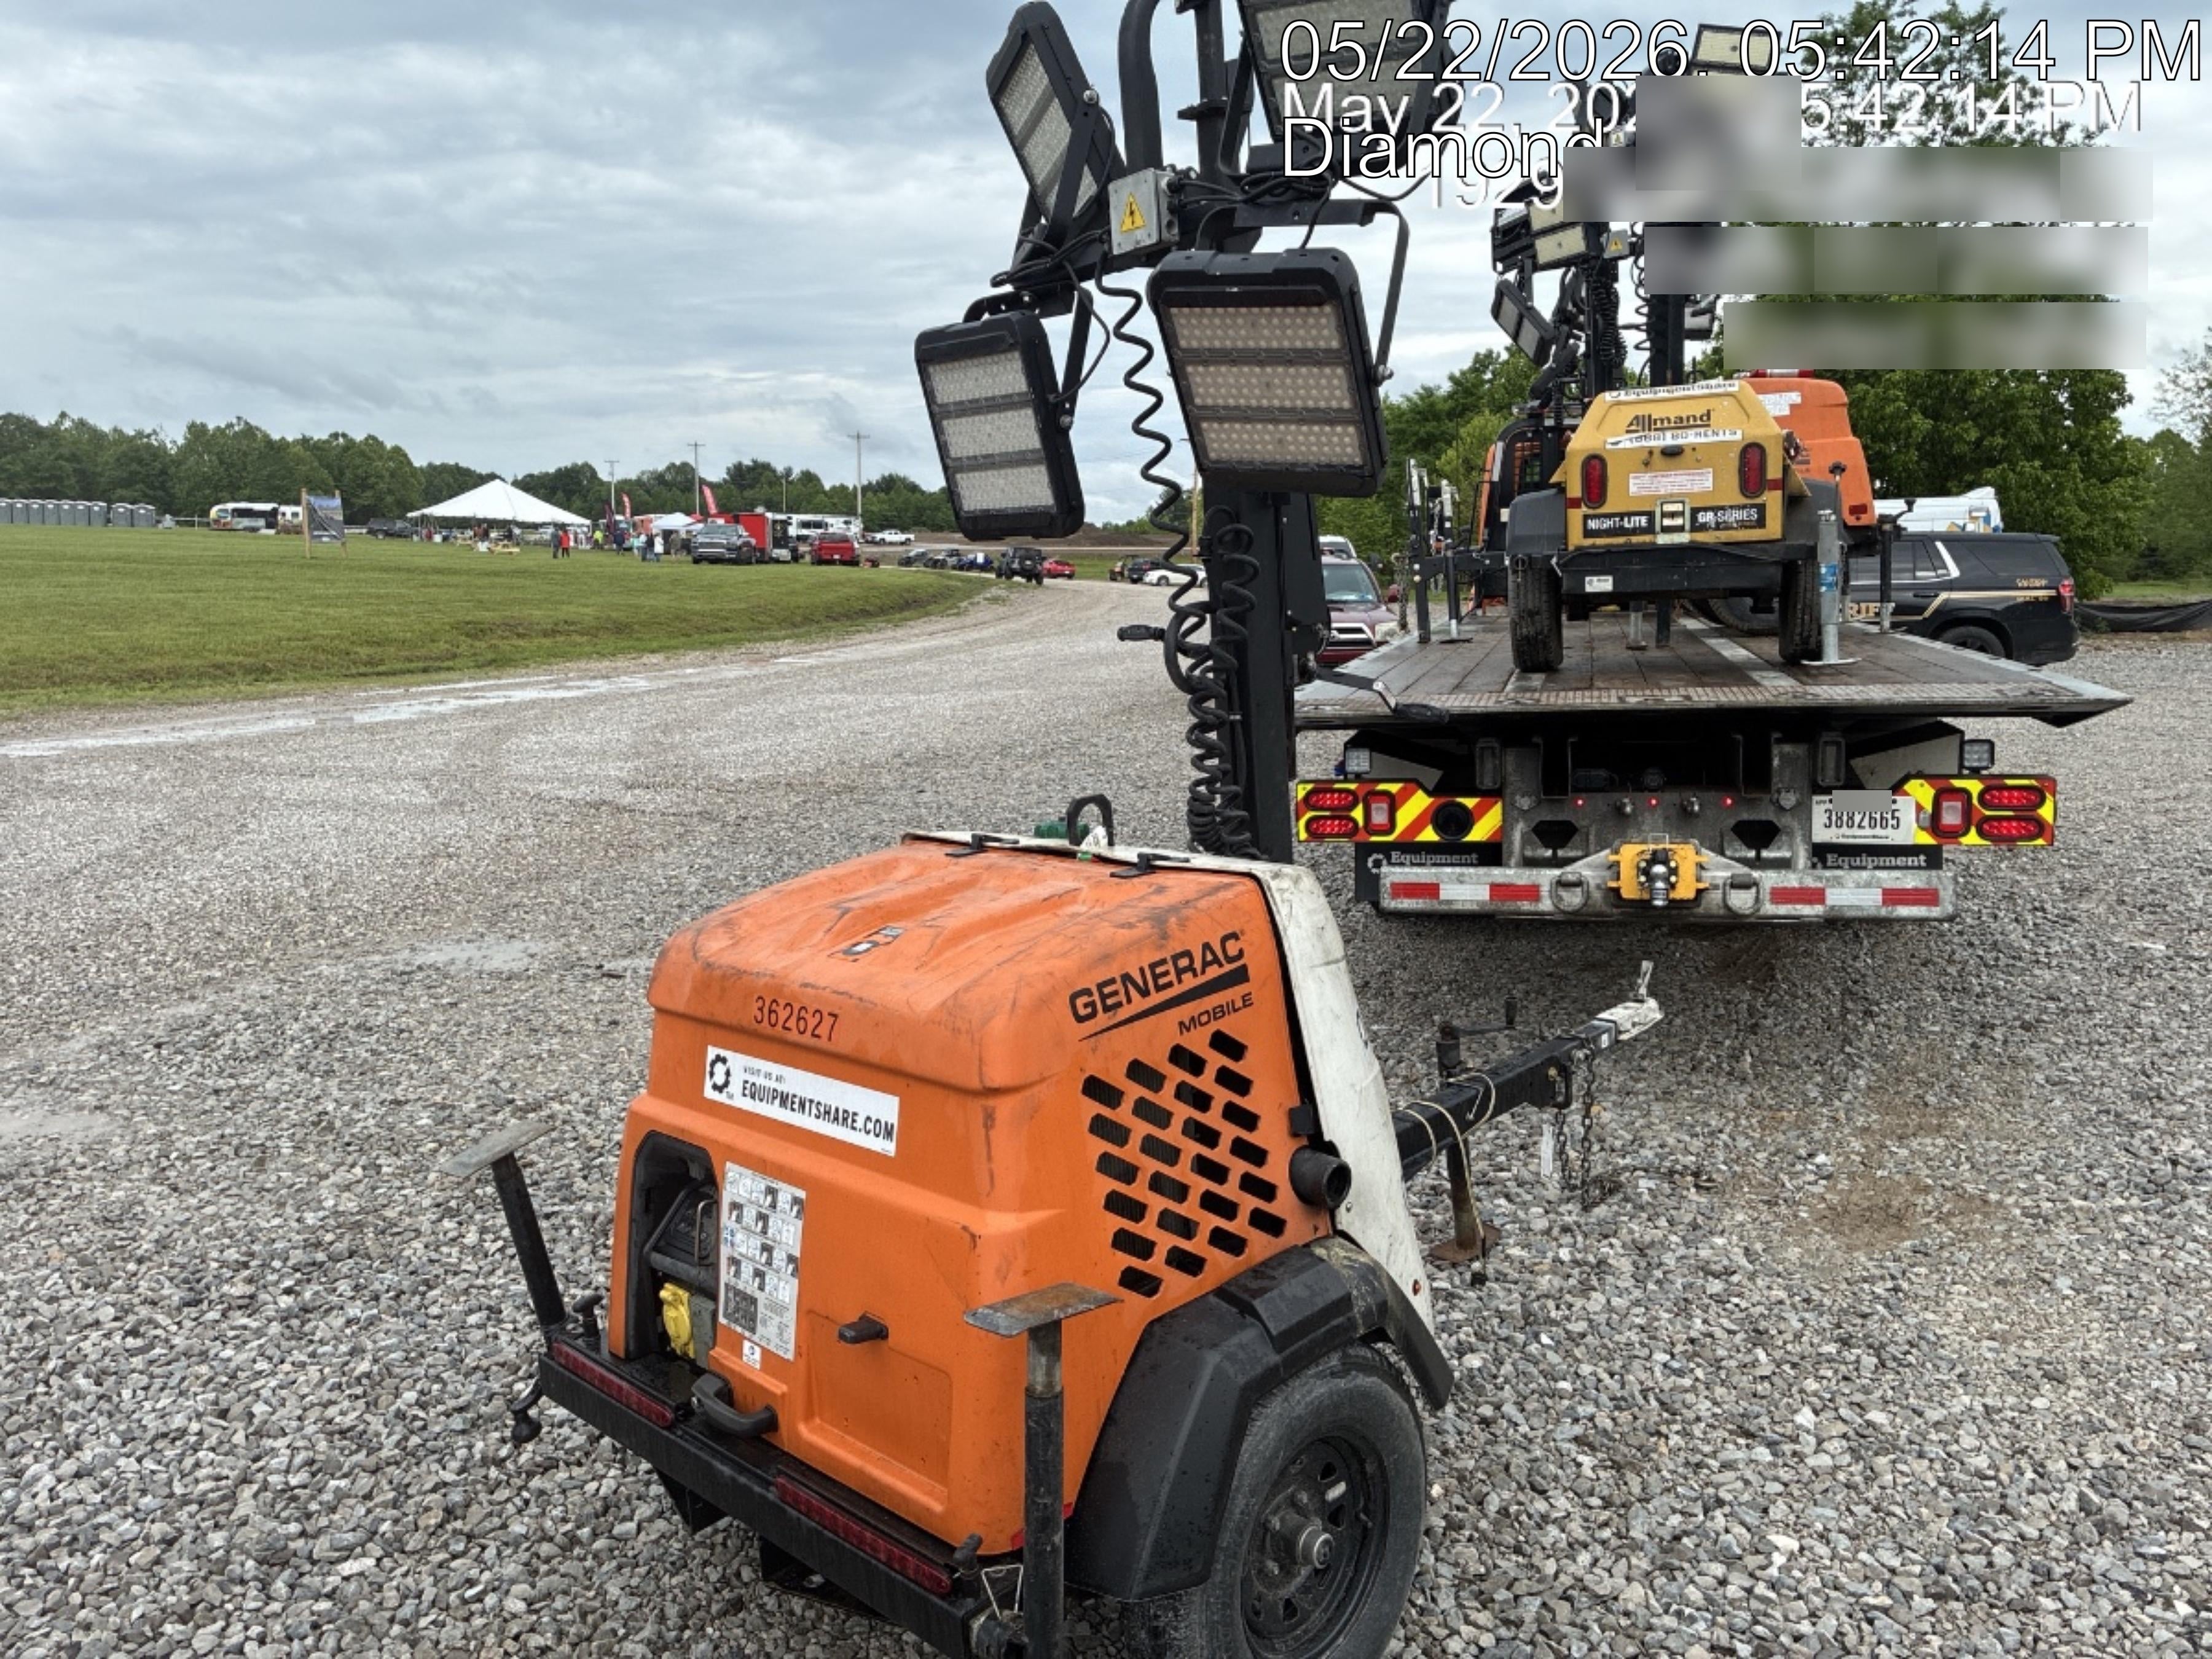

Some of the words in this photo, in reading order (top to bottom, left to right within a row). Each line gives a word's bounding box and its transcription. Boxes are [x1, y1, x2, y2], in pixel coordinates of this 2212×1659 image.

[1625, 408, 1711, 433] Allmand
[1588, 515, 1649, 530] NIGHT-LITE
[1390, 851, 1479, 866] Equipment
[1826, 853, 1927, 869] Equipment
[1068, 930, 1245, 1024] GENERAC
[753, 996, 841, 1042] 362627
[1178, 992, 1254, 1036] MOBILE
[742, 1079, 895, 1143] EQUIPMENTSHARE.COM
